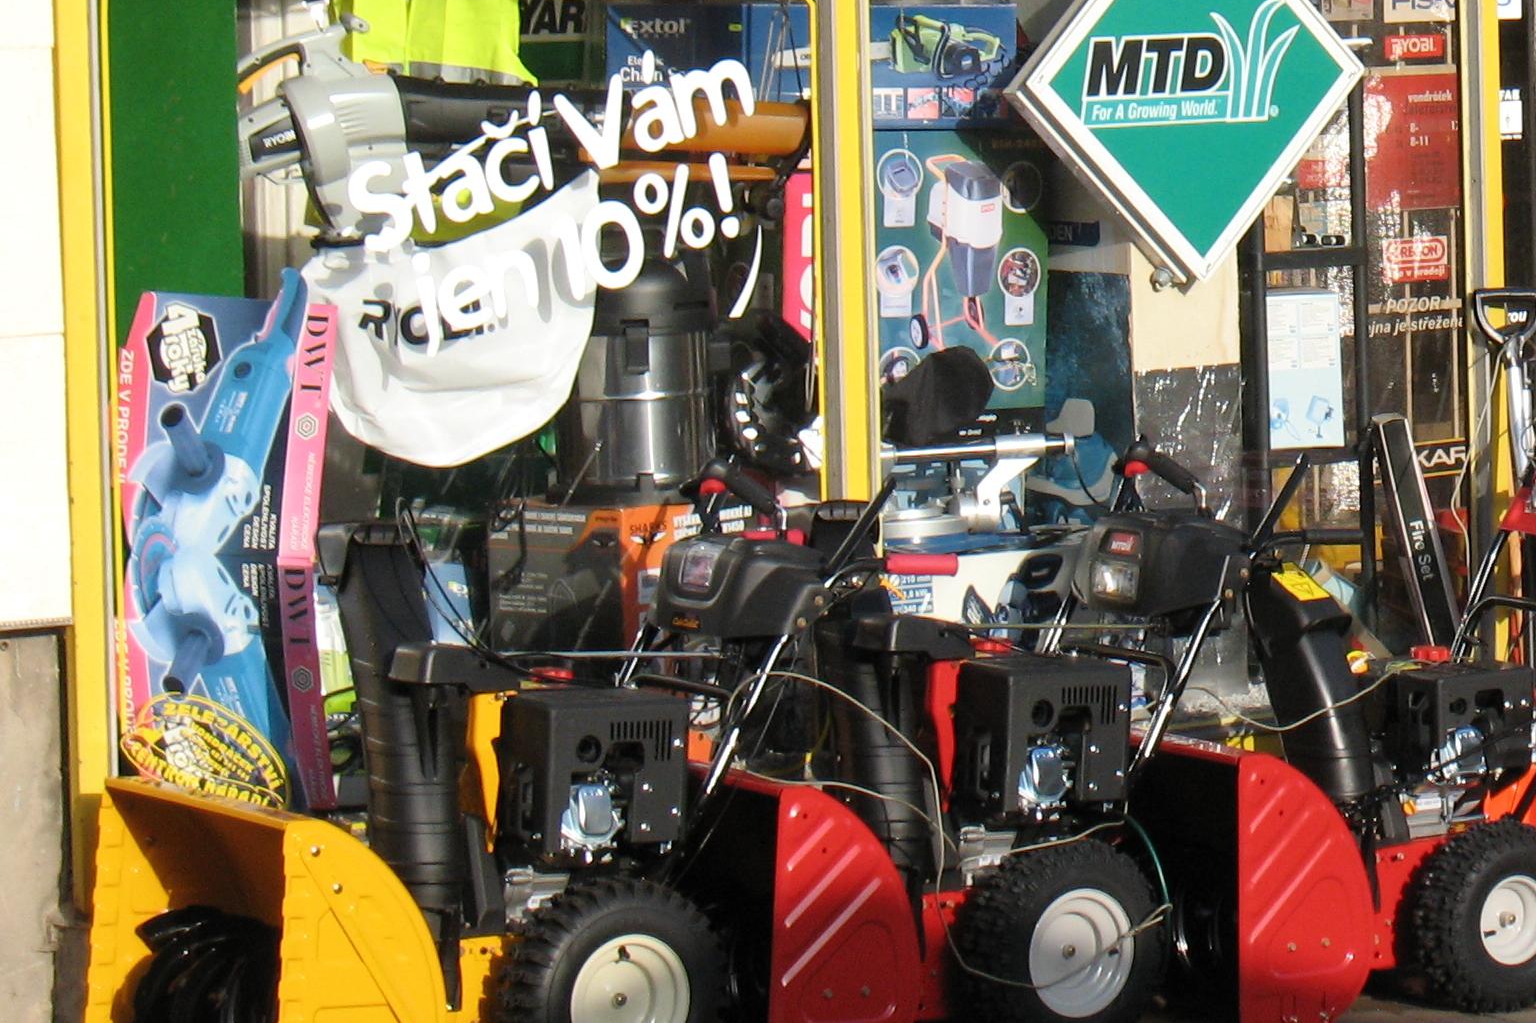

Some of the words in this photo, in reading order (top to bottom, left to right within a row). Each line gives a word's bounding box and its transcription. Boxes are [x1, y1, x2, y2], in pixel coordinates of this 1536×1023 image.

[1084, 34, 1227, 98] MTD
[553, 49, 757, 170] Vám
[1092, 104, 1111, 122] For
[1115, 104, 1124, 120] A
[1128, 102, 1177, 121] Growing
[1181, 100, 1218, 117] World.
[411, 251, 540, 358] jen
[1386, 296, 1441, 315] POZOR
[119, 349, 134, 385] ZDE
[1418, 553, 1435, 582] Set
